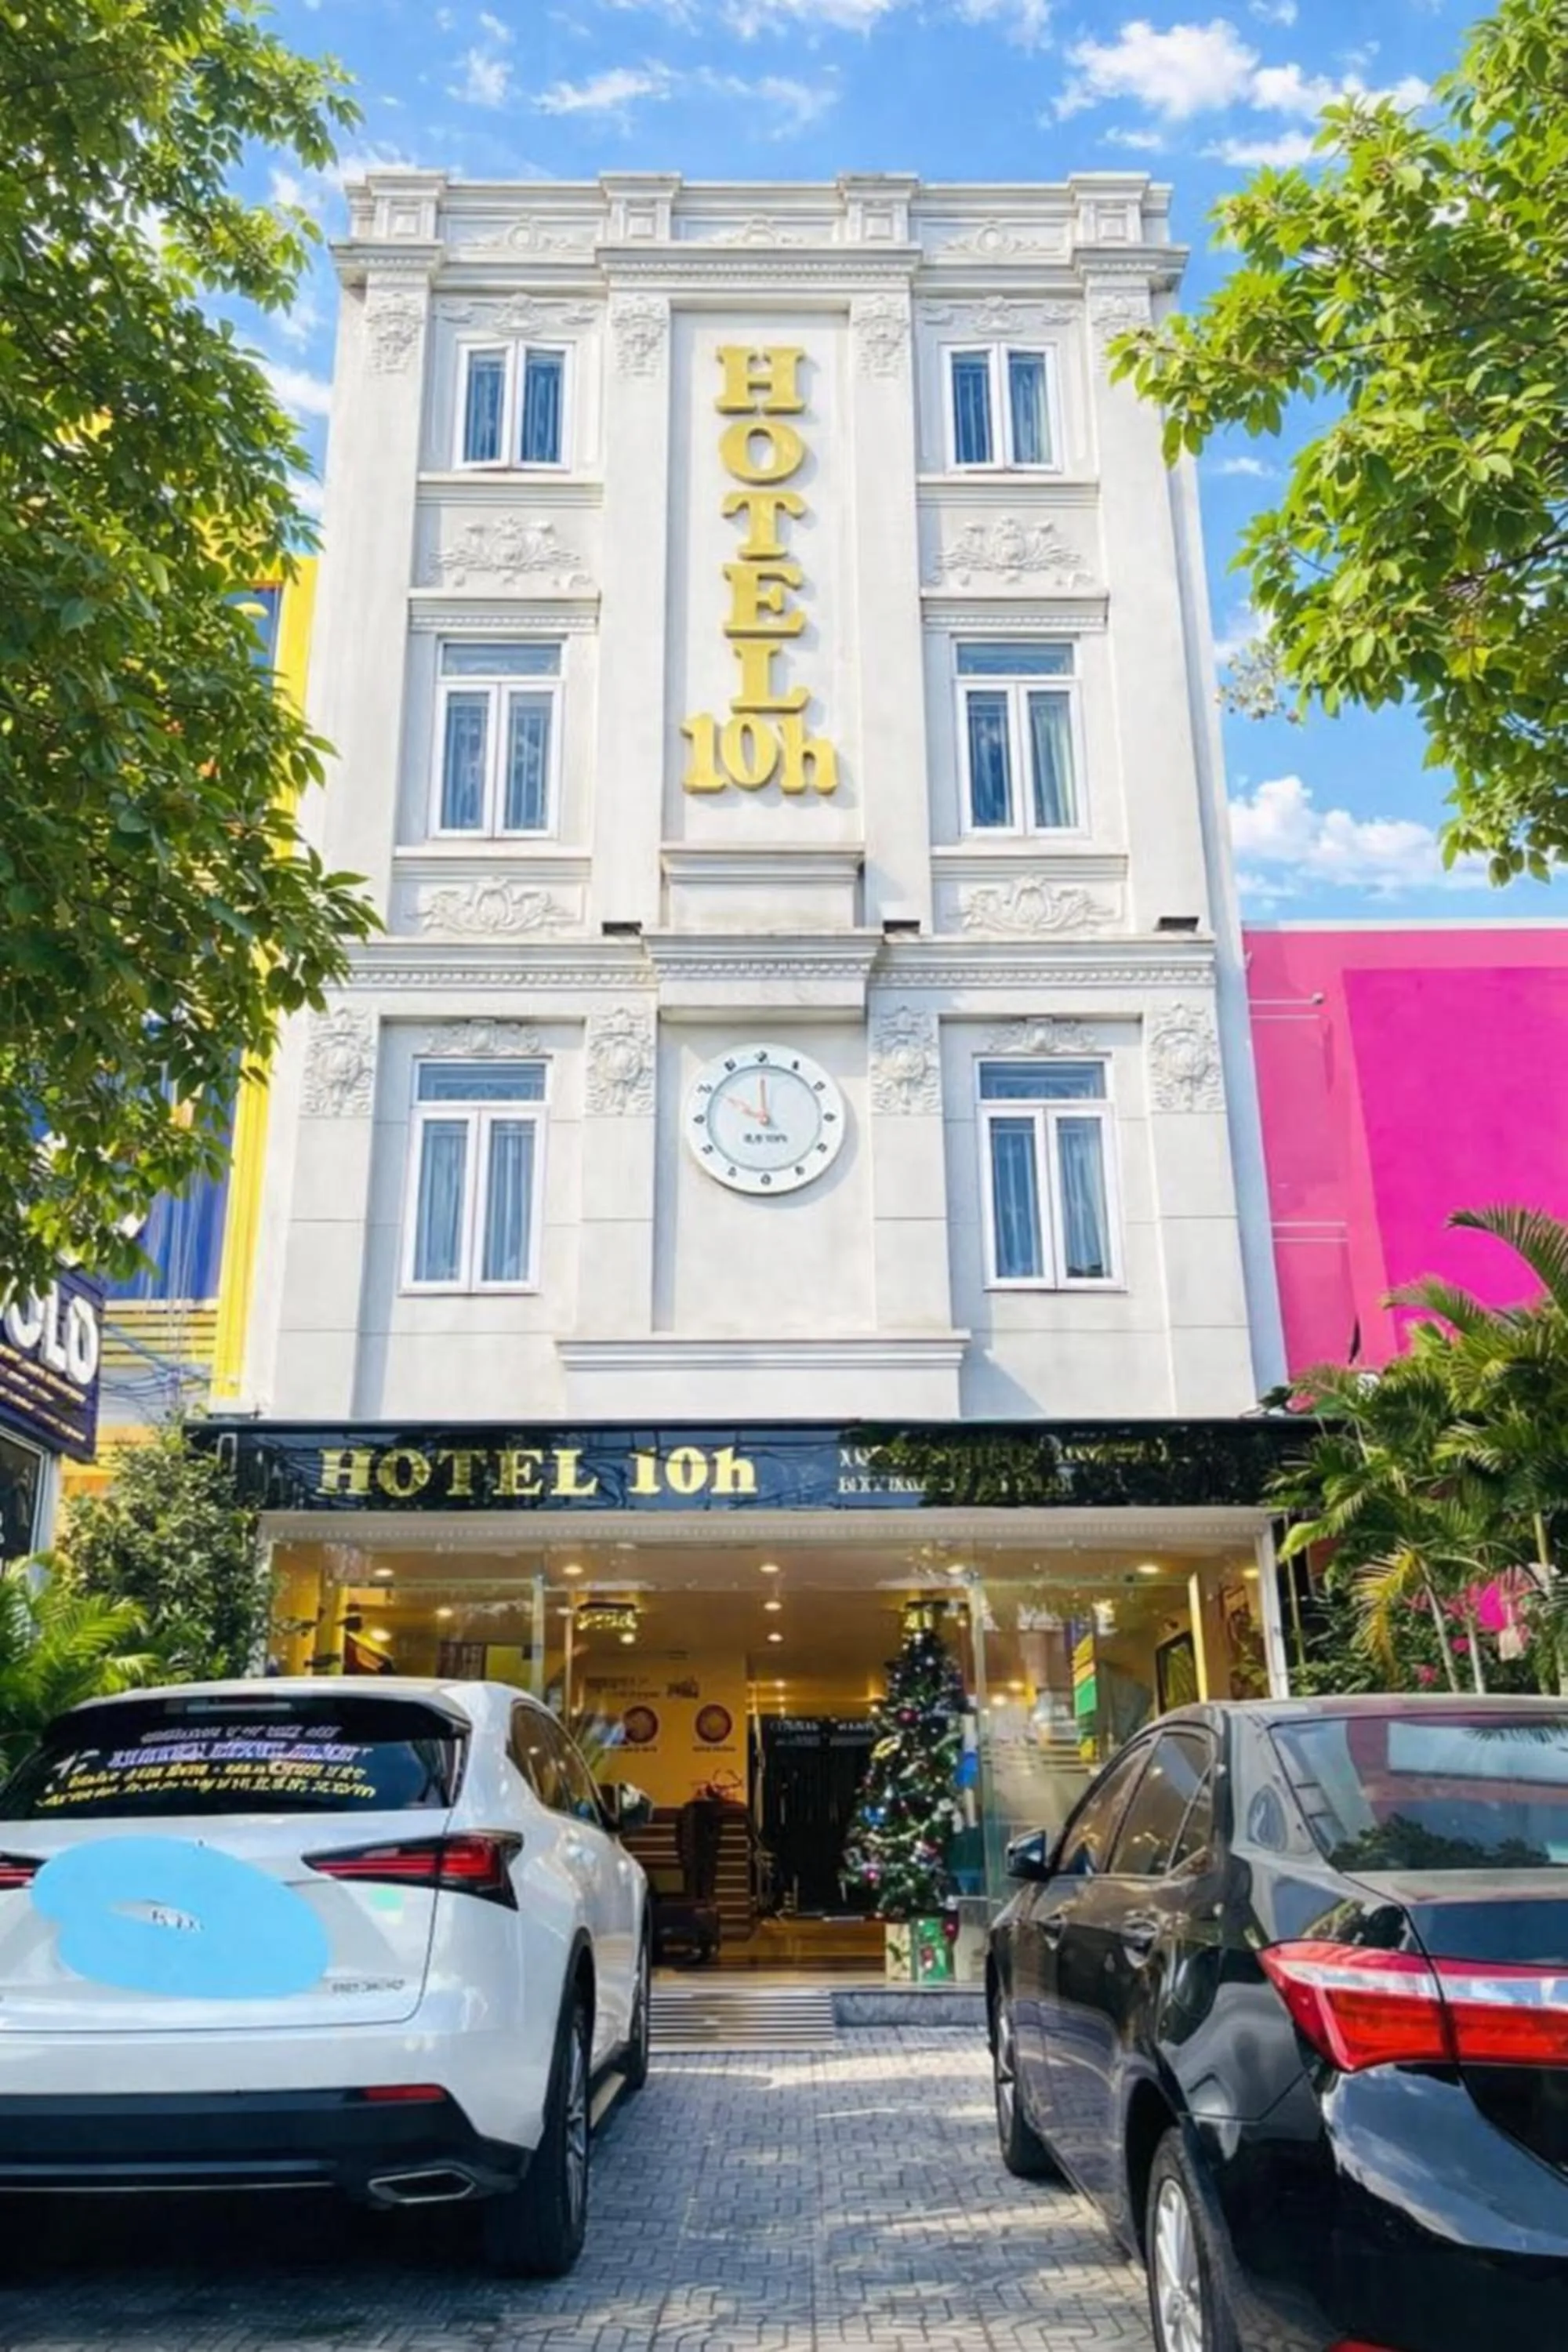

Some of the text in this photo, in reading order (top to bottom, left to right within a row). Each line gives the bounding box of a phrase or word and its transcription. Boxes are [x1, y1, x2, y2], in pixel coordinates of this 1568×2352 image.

[714, 345, 809, 714] HOTEL
[680, 713, 838, 795] 10h
[315, 1445, 759, 1497] HOTEL 10h
